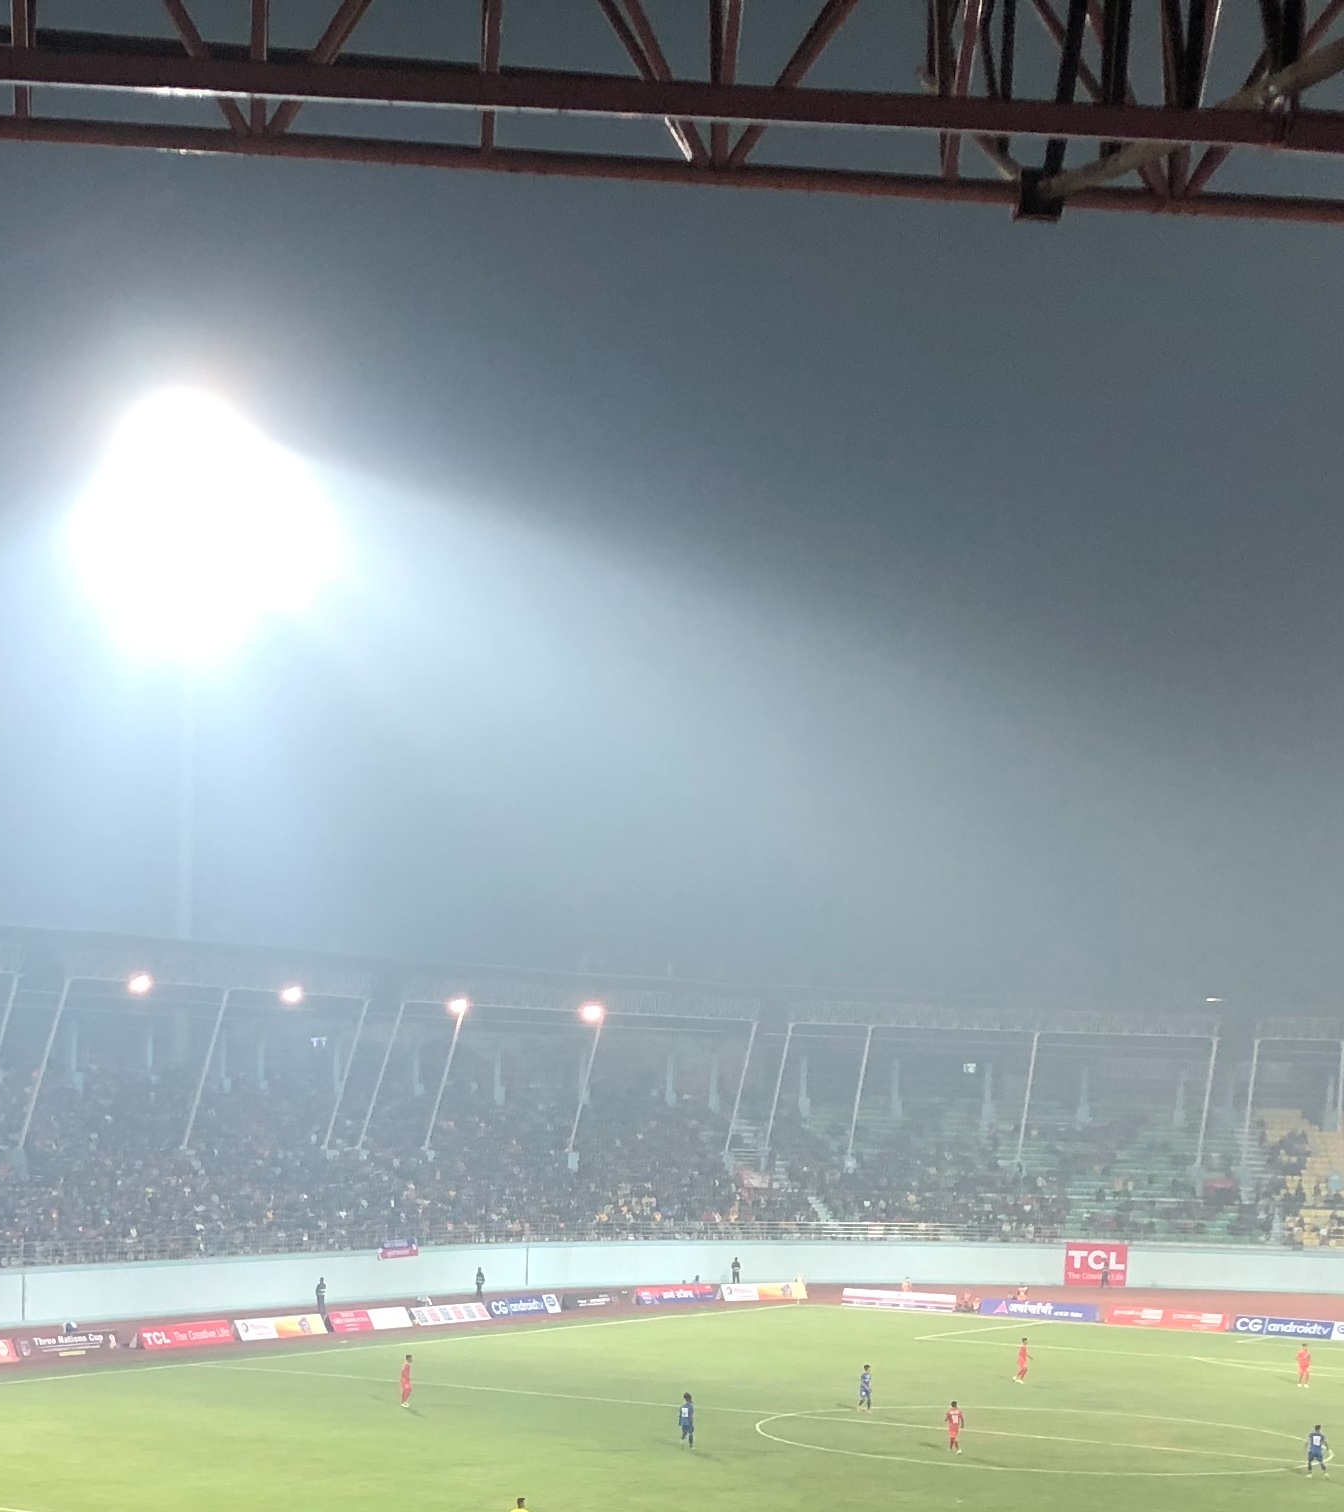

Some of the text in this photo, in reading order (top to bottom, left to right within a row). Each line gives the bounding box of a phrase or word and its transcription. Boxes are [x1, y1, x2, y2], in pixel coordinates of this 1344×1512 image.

[1068, 1250, 1126, 1270] TCL
[491, 1300, 509, 1315] CG
[1236, 1317, 1332, 1336] CG androidtv
[142, 1332, 172, 1346] TCL
